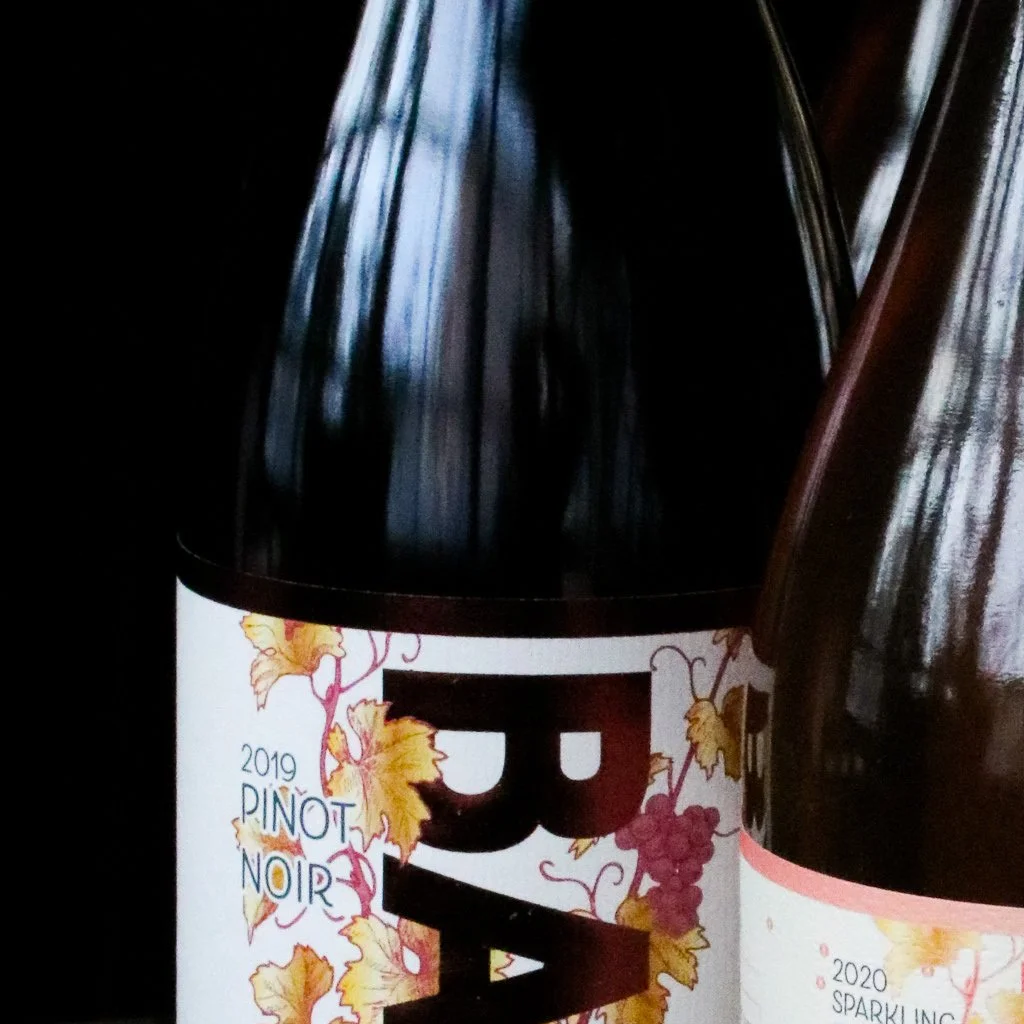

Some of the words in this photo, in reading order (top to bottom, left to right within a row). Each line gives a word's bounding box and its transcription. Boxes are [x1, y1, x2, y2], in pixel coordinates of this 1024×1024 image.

[241, 743, 297, 782] 2019
[242, 783, 356, 843] PINOT
[242, 847, 333, 907] NOIR
[833, 958, 887, 992] 2020
